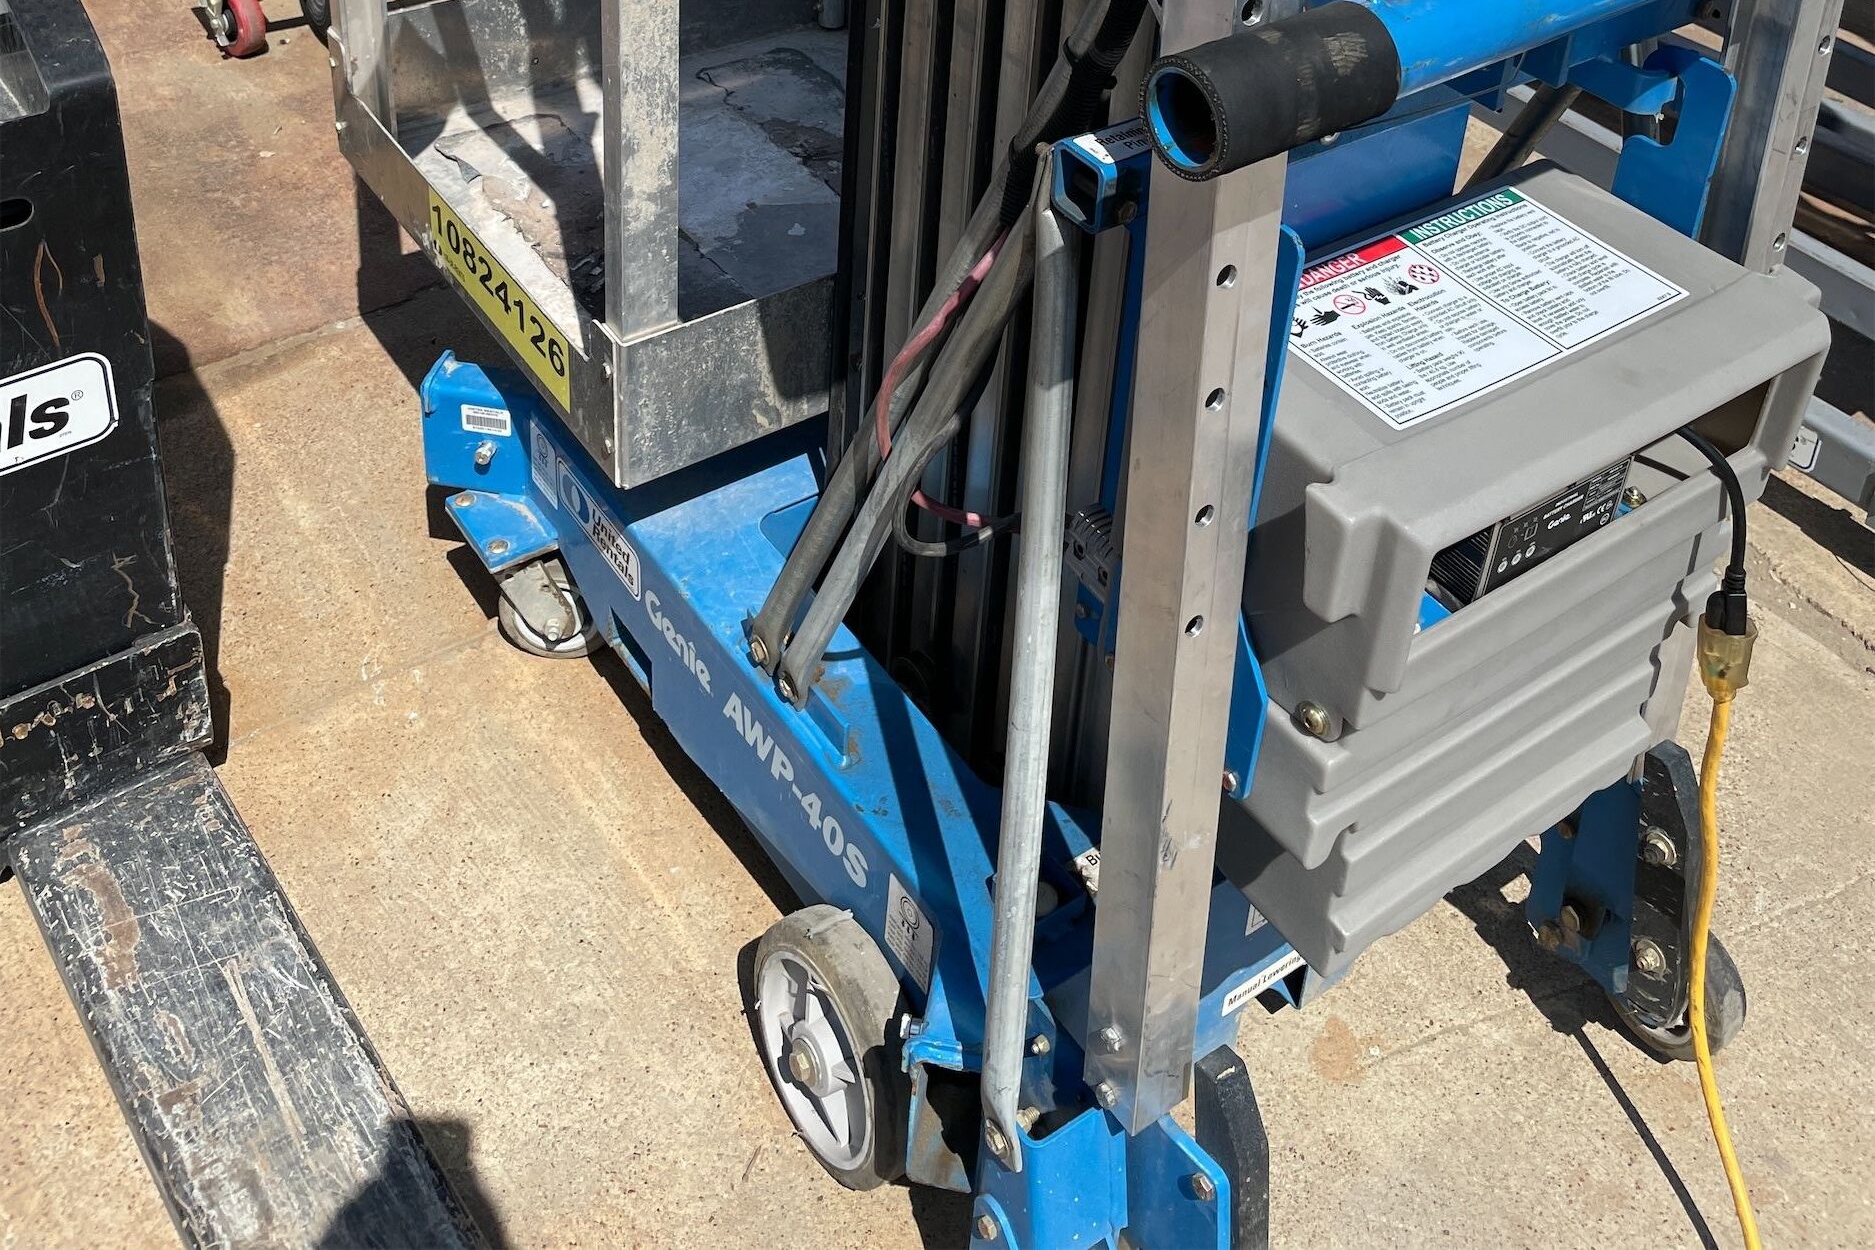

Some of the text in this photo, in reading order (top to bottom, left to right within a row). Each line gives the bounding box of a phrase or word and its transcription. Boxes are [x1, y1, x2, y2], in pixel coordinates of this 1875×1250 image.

[1123, 137, 1147, 150] Pin
[1409, 193, 1513, 240] INSTRUCTIONS
[432, 205, 565, 377] 10824126
[1302, 252, 1367, 286] DANGER
[1312, 290, 1332, 301] cause
[1330, 282, 1350, 293] death
[1356, 270, 1381, 283] serious
[1313, 277, 1344, 293] following
[1342, 268, 1366, 281] battery
[1376, 254, 1402, 267] charger
[1, 393, 70, 450] ls
[592, 508, 630, 565] United
[593, 524, 634, 586] Rentals
[645, 590, 868, 888] Genie AWP-40S
[1228, 954, 1301, 1006] Manual Lowering
